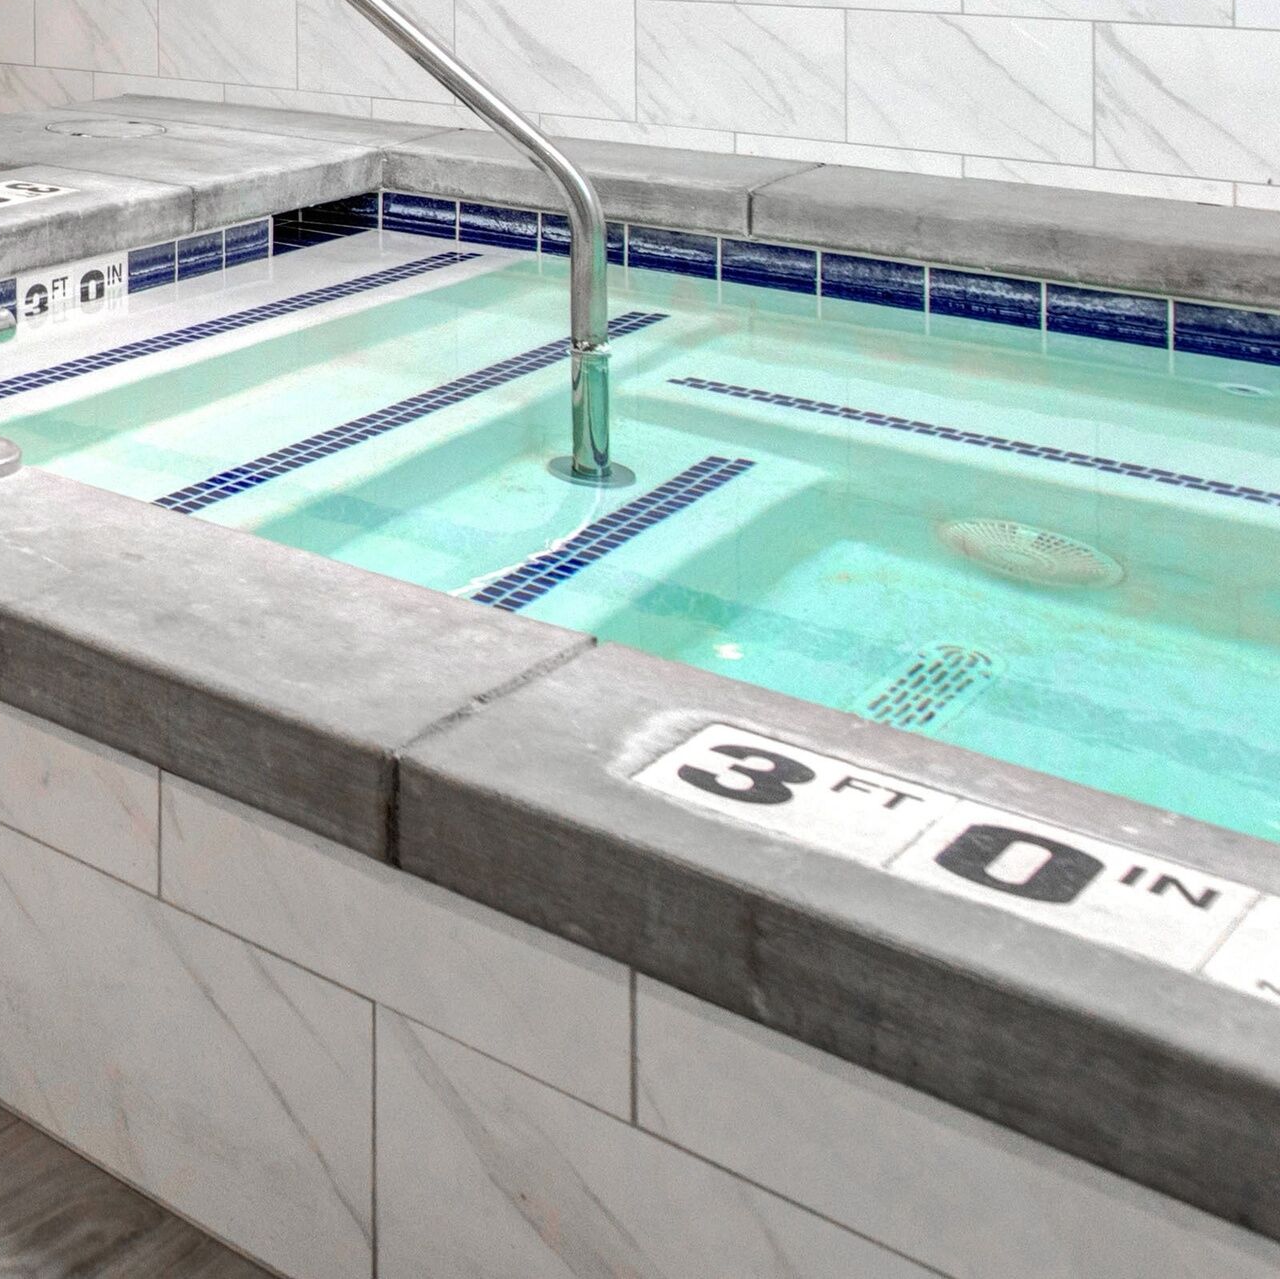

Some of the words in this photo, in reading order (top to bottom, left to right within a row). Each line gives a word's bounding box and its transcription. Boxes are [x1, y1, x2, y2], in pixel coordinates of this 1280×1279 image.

[6, 182, 60, 193] 3
[25, 283, 48, 317] 3
[51, 276, 69, 300] FT
[80, 269, 105, 303] 0
[107, 263, 122, 286] IN
[677, 743, 816, 806] 3
[832, 775, 926, 810] FT
[934, 823, 1105, 906] 0
[1118, 865, 1222, 910] IN
